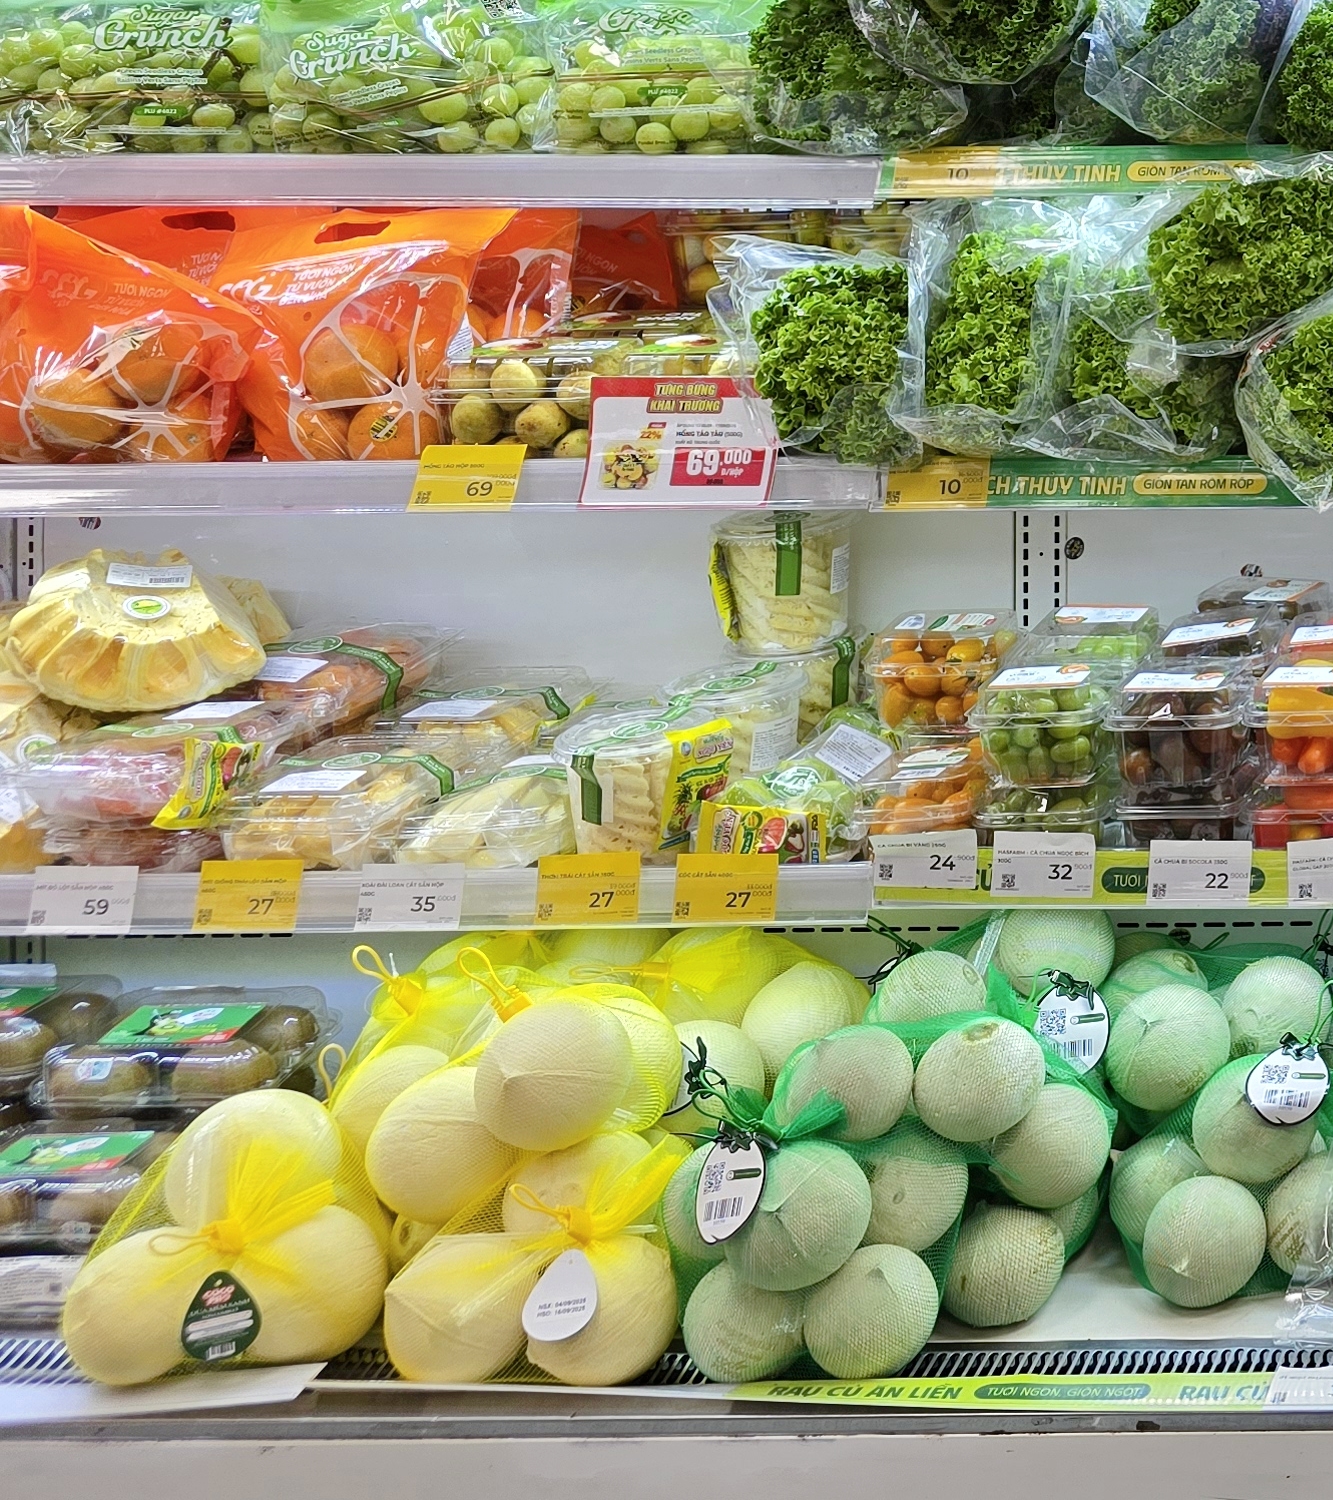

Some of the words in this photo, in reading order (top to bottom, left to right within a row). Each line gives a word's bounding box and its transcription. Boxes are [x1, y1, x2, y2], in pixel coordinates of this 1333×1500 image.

[130, 3, 200, 28] Sugar
[93, 18, 232, 51] Crunch
[648, 399, 677, 415] KHAI
[467, 482, 492, 496] 69
[1018, 471, 1075, 495] THỦY
[1079, 475, 1126, 496] TINH
[1143, 476, 1172, 490] GIÒN
[1175, 477, 1197, 489] TAN
[1200, 476, 1226, 490] RÔM
[930, 855, 955, 870] 24
[411, 896, 435, 911] 35
[767, 1384, 821, 1399] RAU
[825, 1380, 864, 1399] CỦ
[867, 1380, 905, 1399] ĂN
[910, 1379, 963, 1400] LIỀN
